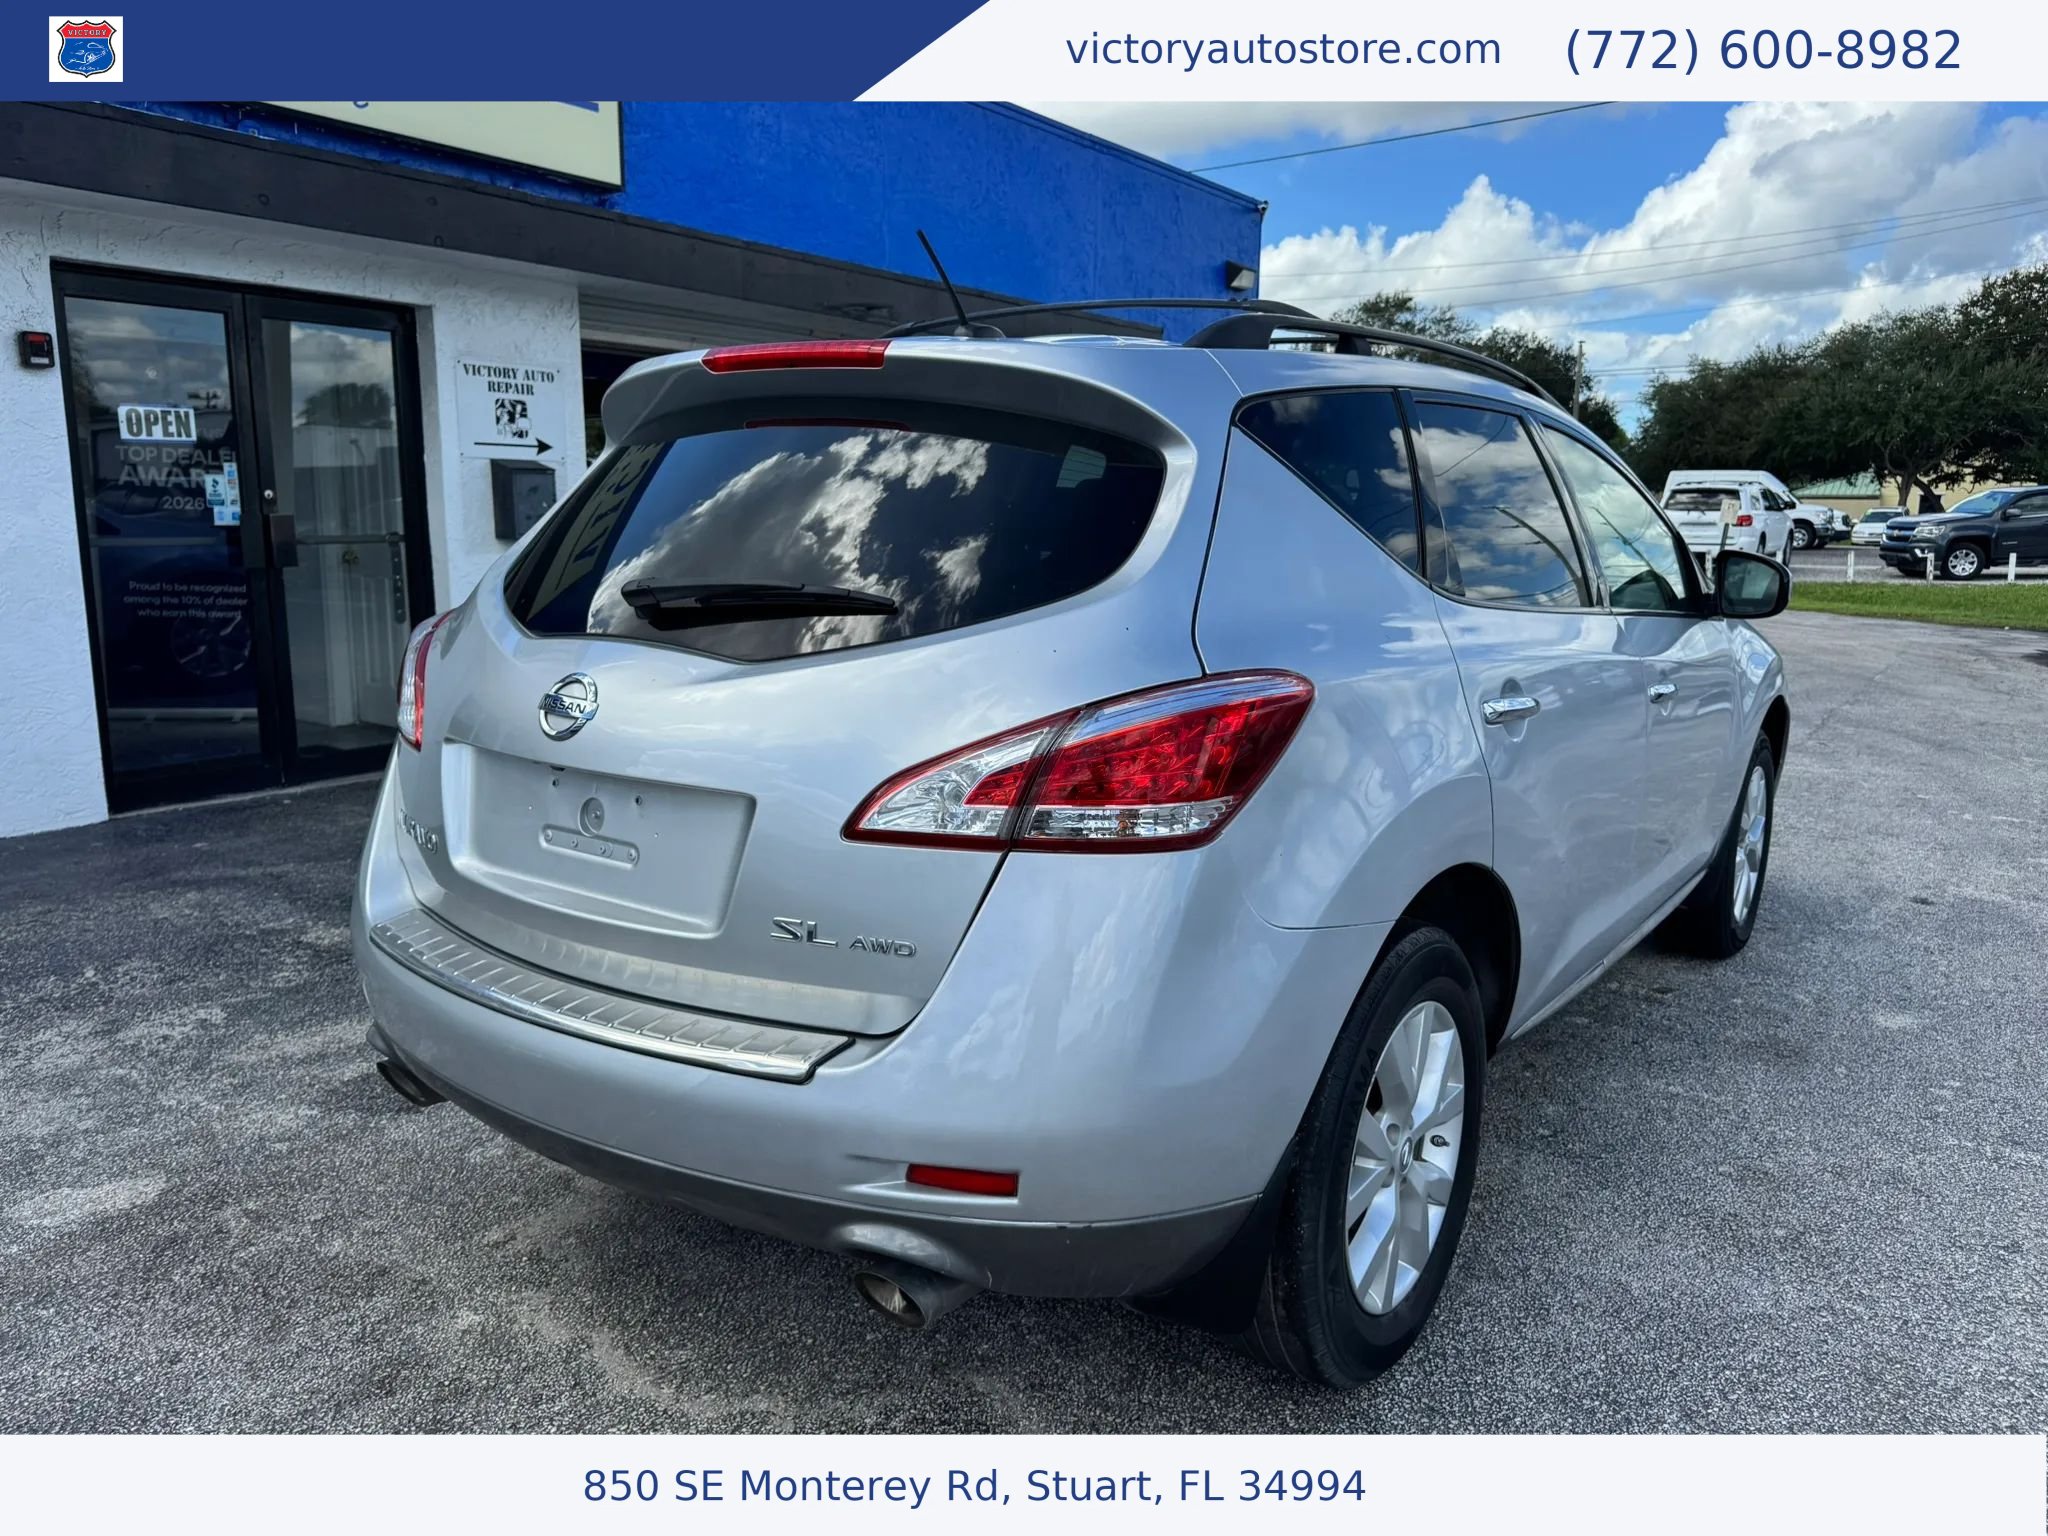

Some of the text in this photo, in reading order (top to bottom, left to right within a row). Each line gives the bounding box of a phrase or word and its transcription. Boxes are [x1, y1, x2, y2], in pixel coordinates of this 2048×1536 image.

[463, 363, 555, 384] VICTORY AUTO
[487, 381, 535, 396] REPAIR
[125, 407, 193, 439] OPEN
[115, 445, 158, 462] TOP
[118, 464, 206, 489] AWAR
[543, 694, 587, 715] NISSAN
[770, 916, 917, 958] SL AWD
